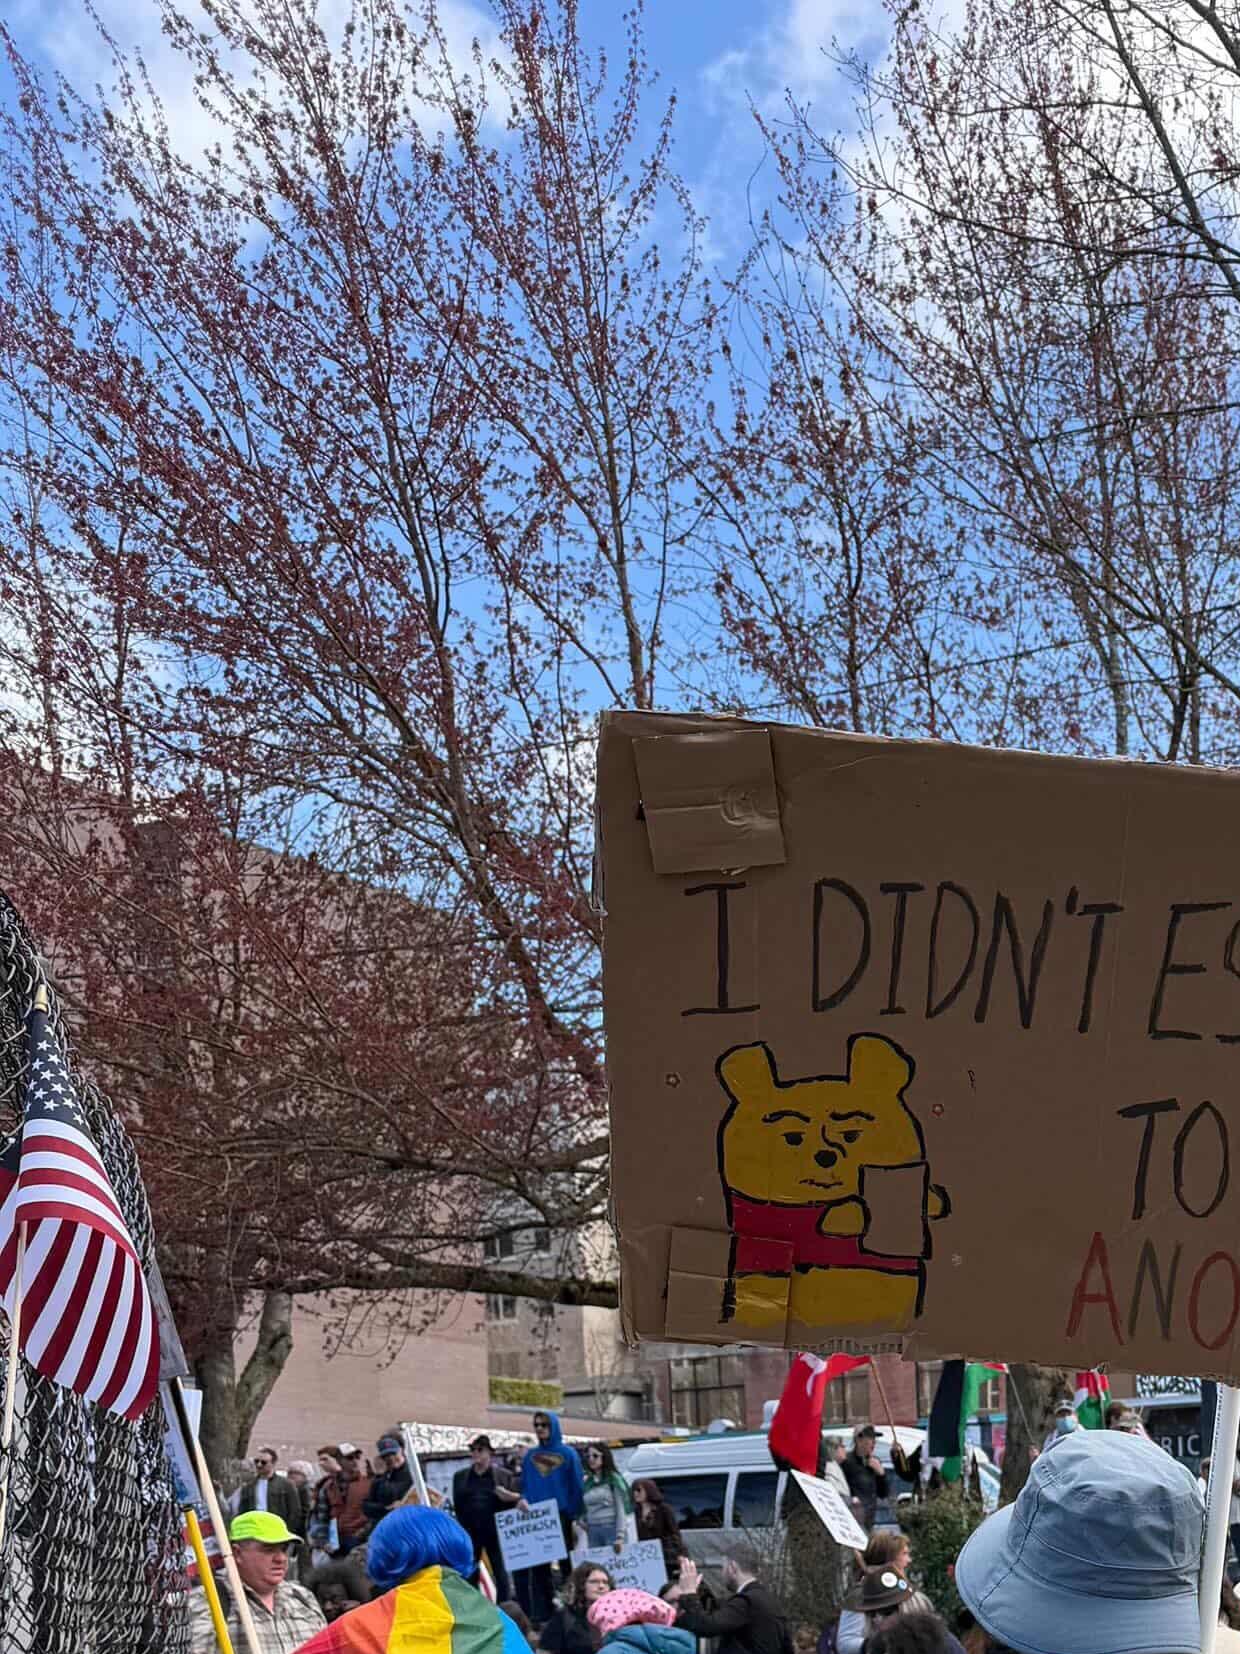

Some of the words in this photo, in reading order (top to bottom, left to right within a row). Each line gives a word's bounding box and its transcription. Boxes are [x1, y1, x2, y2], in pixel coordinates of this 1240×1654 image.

[681, 880, 760, 1015] I
[812, 877, 1124, 1033] DIDN'T
[1116, 1098, 1230, 1221] TO
[1159, 1433, 1201, 1457] RIC
